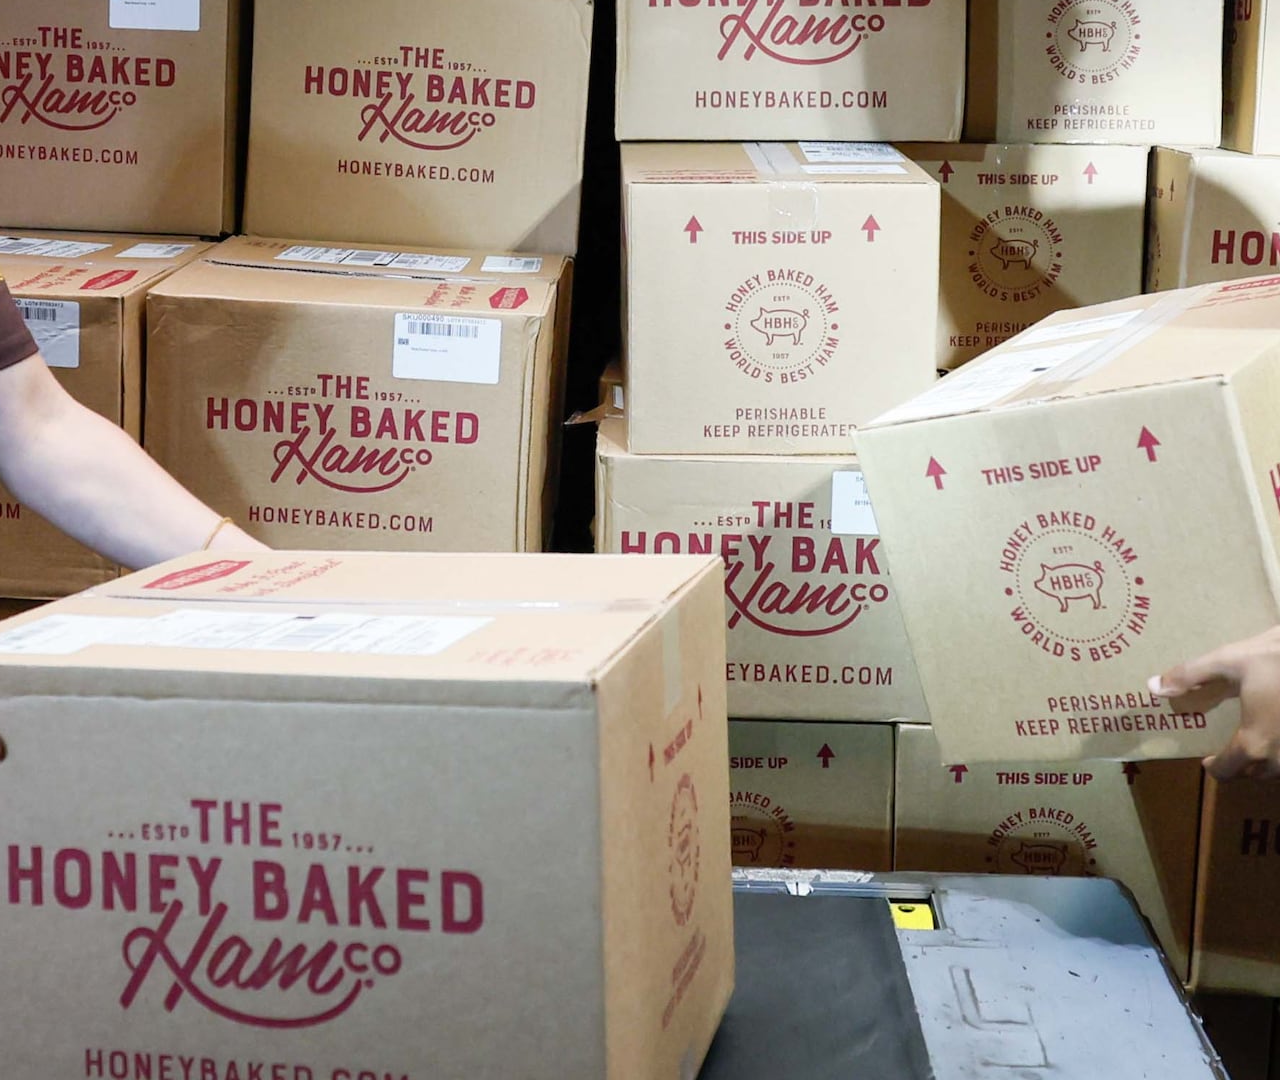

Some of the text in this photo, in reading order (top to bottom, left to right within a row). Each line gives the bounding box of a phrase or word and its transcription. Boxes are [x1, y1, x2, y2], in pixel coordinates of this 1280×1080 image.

[851, 14, 885, 32] CO
[1121, 0, 1141, 26] HAM
[38, 26, 83, 49] THE
[66, 53, 176, 88] BAKED
[400, 46, 444, 69] THE
[1092, 45, 1141, 84] BEST HAM
[304, 65, 536, 109] HONEY BAKED
[695, 91, 888, 108] HONEYBAKED.COM
[0, 73, 137, 131] Ham CO
[1054, 104, 1129, 116] PERISHABLE
[358, 92, 495, 150] Ham CO
[1027, 118, 1155, 131] KEEP REFRIGERATED
[338, 159, 495, 183] HONEYBAKED.COM
[977, 173, 1058, 185] THIS SIDE UP
[732, 231, 832, 245] THIS SIDE UP
[970, 205, 1063, 244] HONEY BAKED HAM
[725, 269, 839, 314] HONEY BAKED HAM
[1013, 263, 1062, 302] BEST HAM
[949, 336, 980, 347] KEEP
[781, 363, 815, 384] BEST
[815, 336, 840, 366] HAM
[317, 374, 370, 400] THE
[206, 397, 480, 444] HONEY BAKED
[736, 407, 826, 420] PERISHABLE
[703, 425, 741, 438] KEEP
[270, 425, 433, 493] Ham CO
[981, 454, 1102, 486] THIS SIDE UP
[249, 505, 433, 533] HONEYBAKED.COM
[752, 501, 815, 529] THE
[791, 535, 884, 575] BAK
[1000, 510, 1138, 573] HONEY BAKED HAM
[850, 583, 889, 603] CO
[1089, 633, 1131, 662] BEST
[1127, 595, 1151, 635] HAM
[725, 662, 893, 686] EYBAKED.COM
[1048, 691, 1162, 712] PERISHABLE
[1015, 712, 1208, 737] KEEP REFRIGERATED
[730, 757, 788, 769] SIDE UP
[996, 772, 1093, 786] THIS SIDE UP
[191, 799, 283, 847] THE
[771, 806, 795, 833] HAM
[987, 807, 1097, 850] HONEY BAKED HAM
[7, 845, 485, 935] HONEY BAKED
[119, 898, 402, 1029] Ham CO
